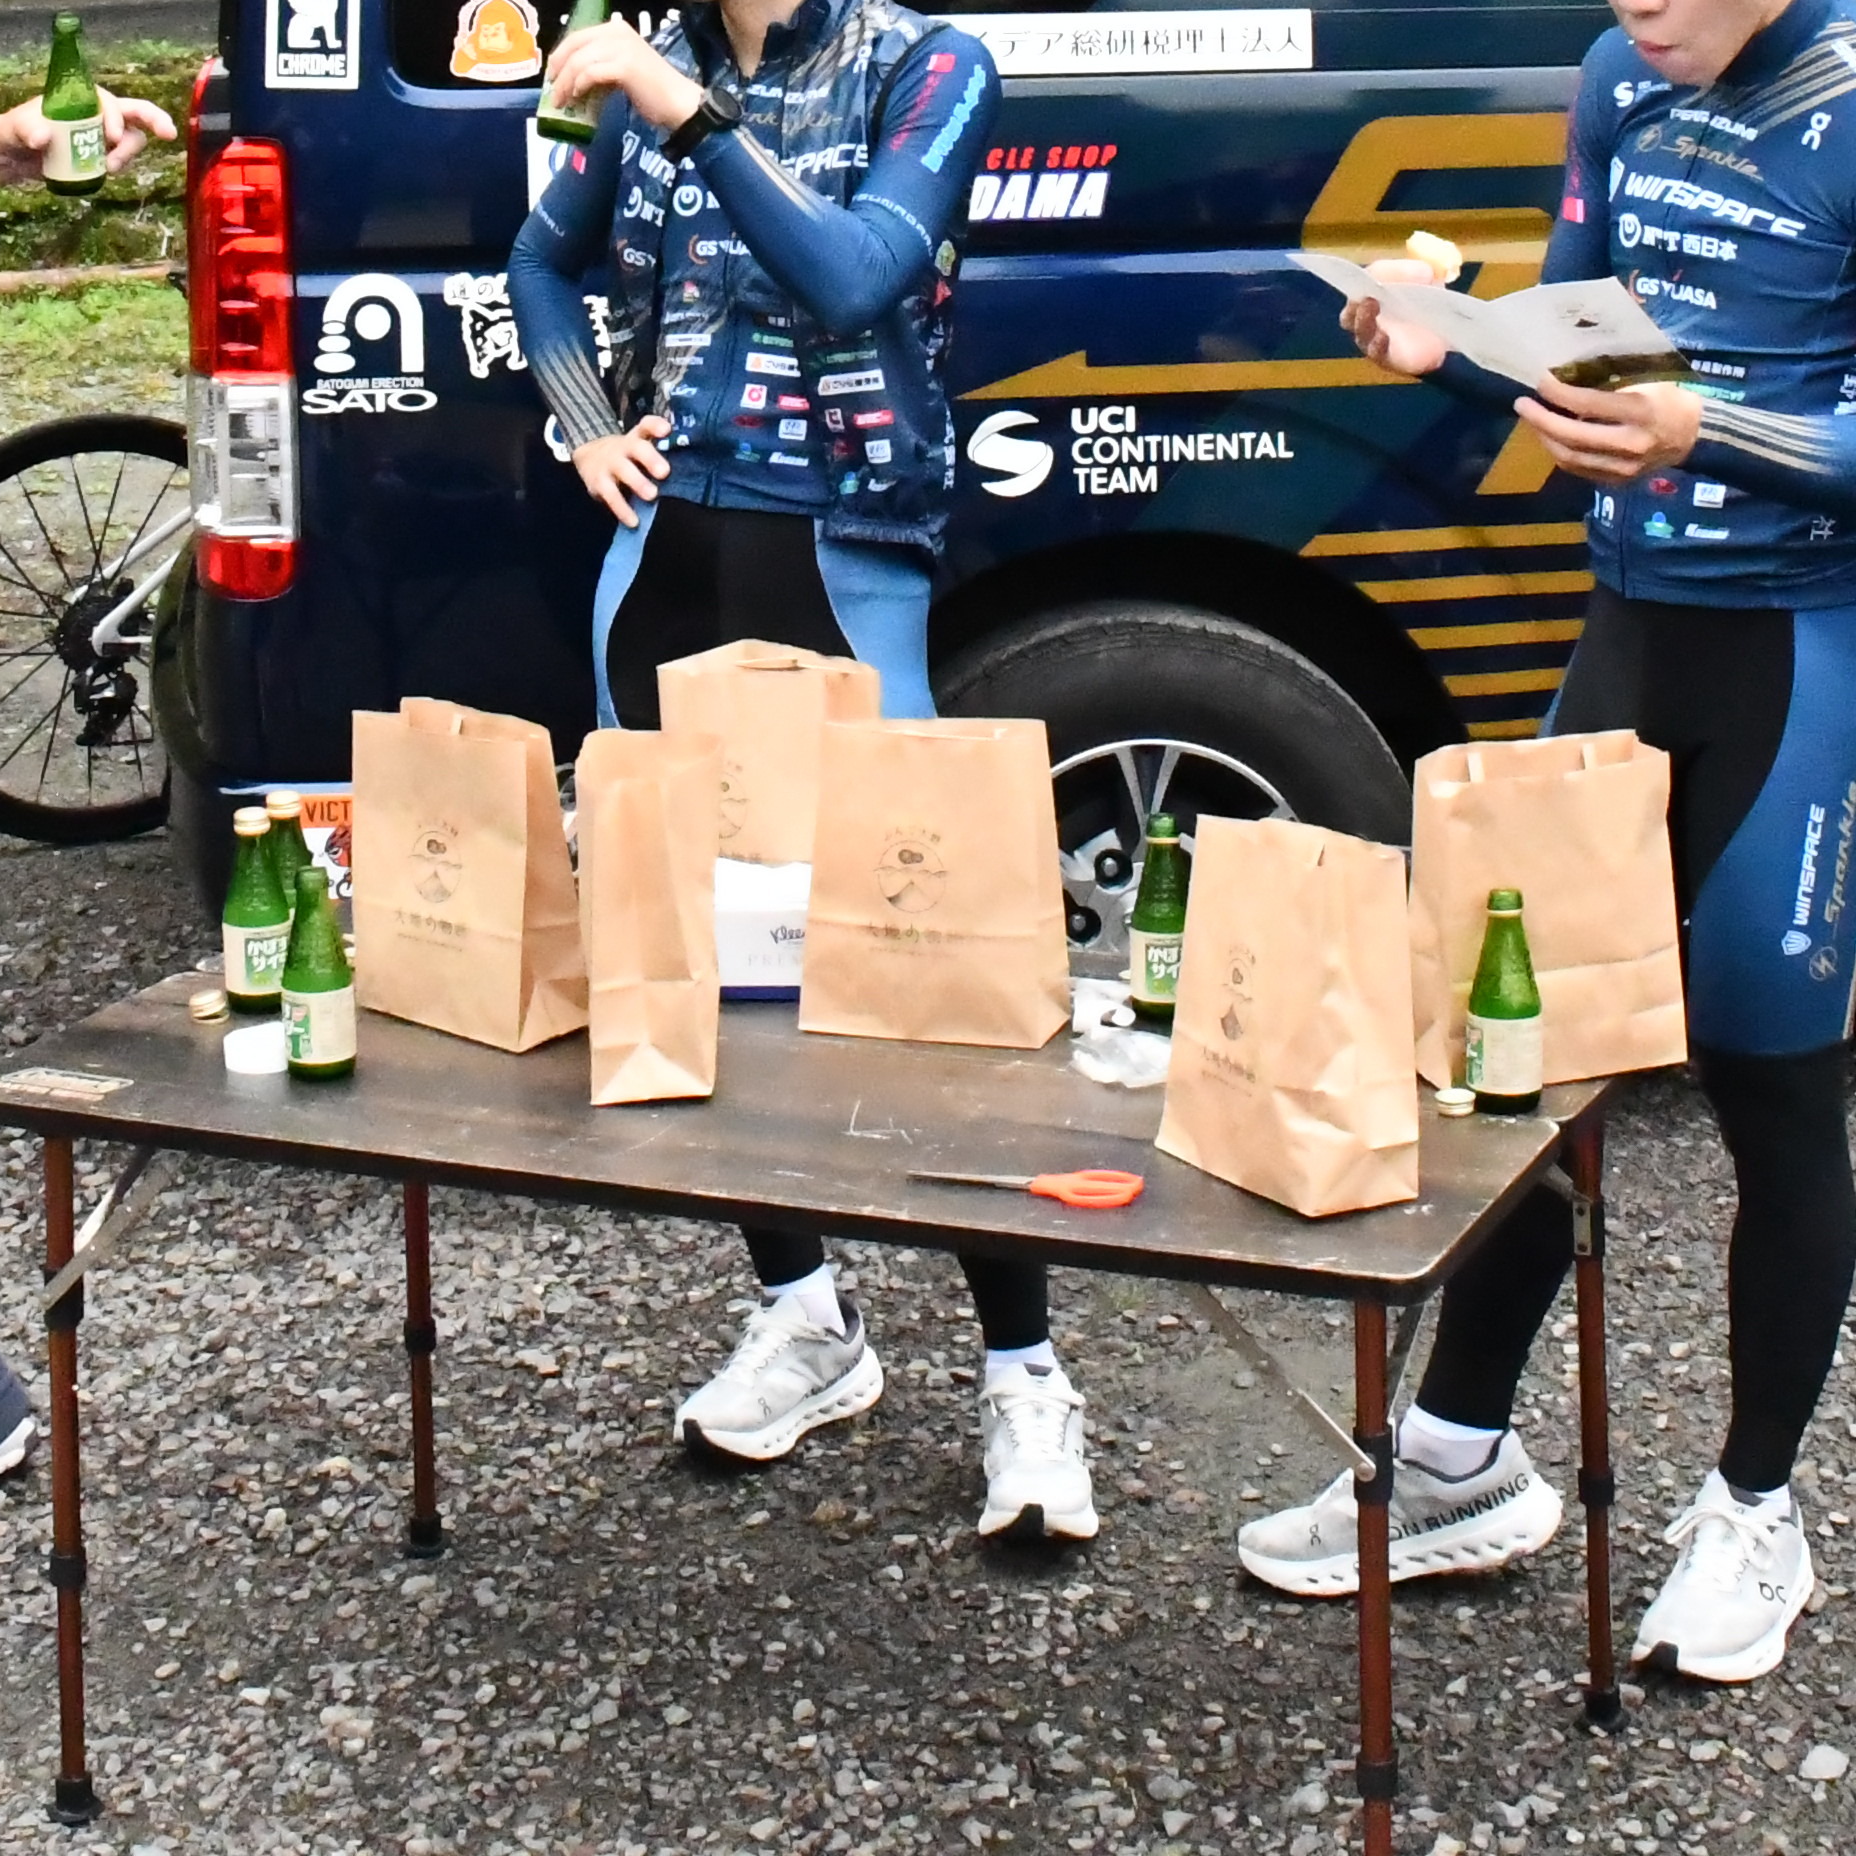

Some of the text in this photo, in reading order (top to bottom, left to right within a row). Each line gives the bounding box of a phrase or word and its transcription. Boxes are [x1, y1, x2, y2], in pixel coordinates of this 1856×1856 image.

[278, 52, 347, 77] CHROME
[985, 146, 1036, 171] CLE
[967, 170, 1110, 222] DAMA
[301, 389, 438, 415] SATO
[1070, 405, 1136, 435] UCI
[1071, 431, 1295, 466] CONTINENTAL
[1072, 466, 1158, 495] TEAM
[303, 799, 352, 823] VICT
[1423, 1471, 1531, 1533] RUNNING
